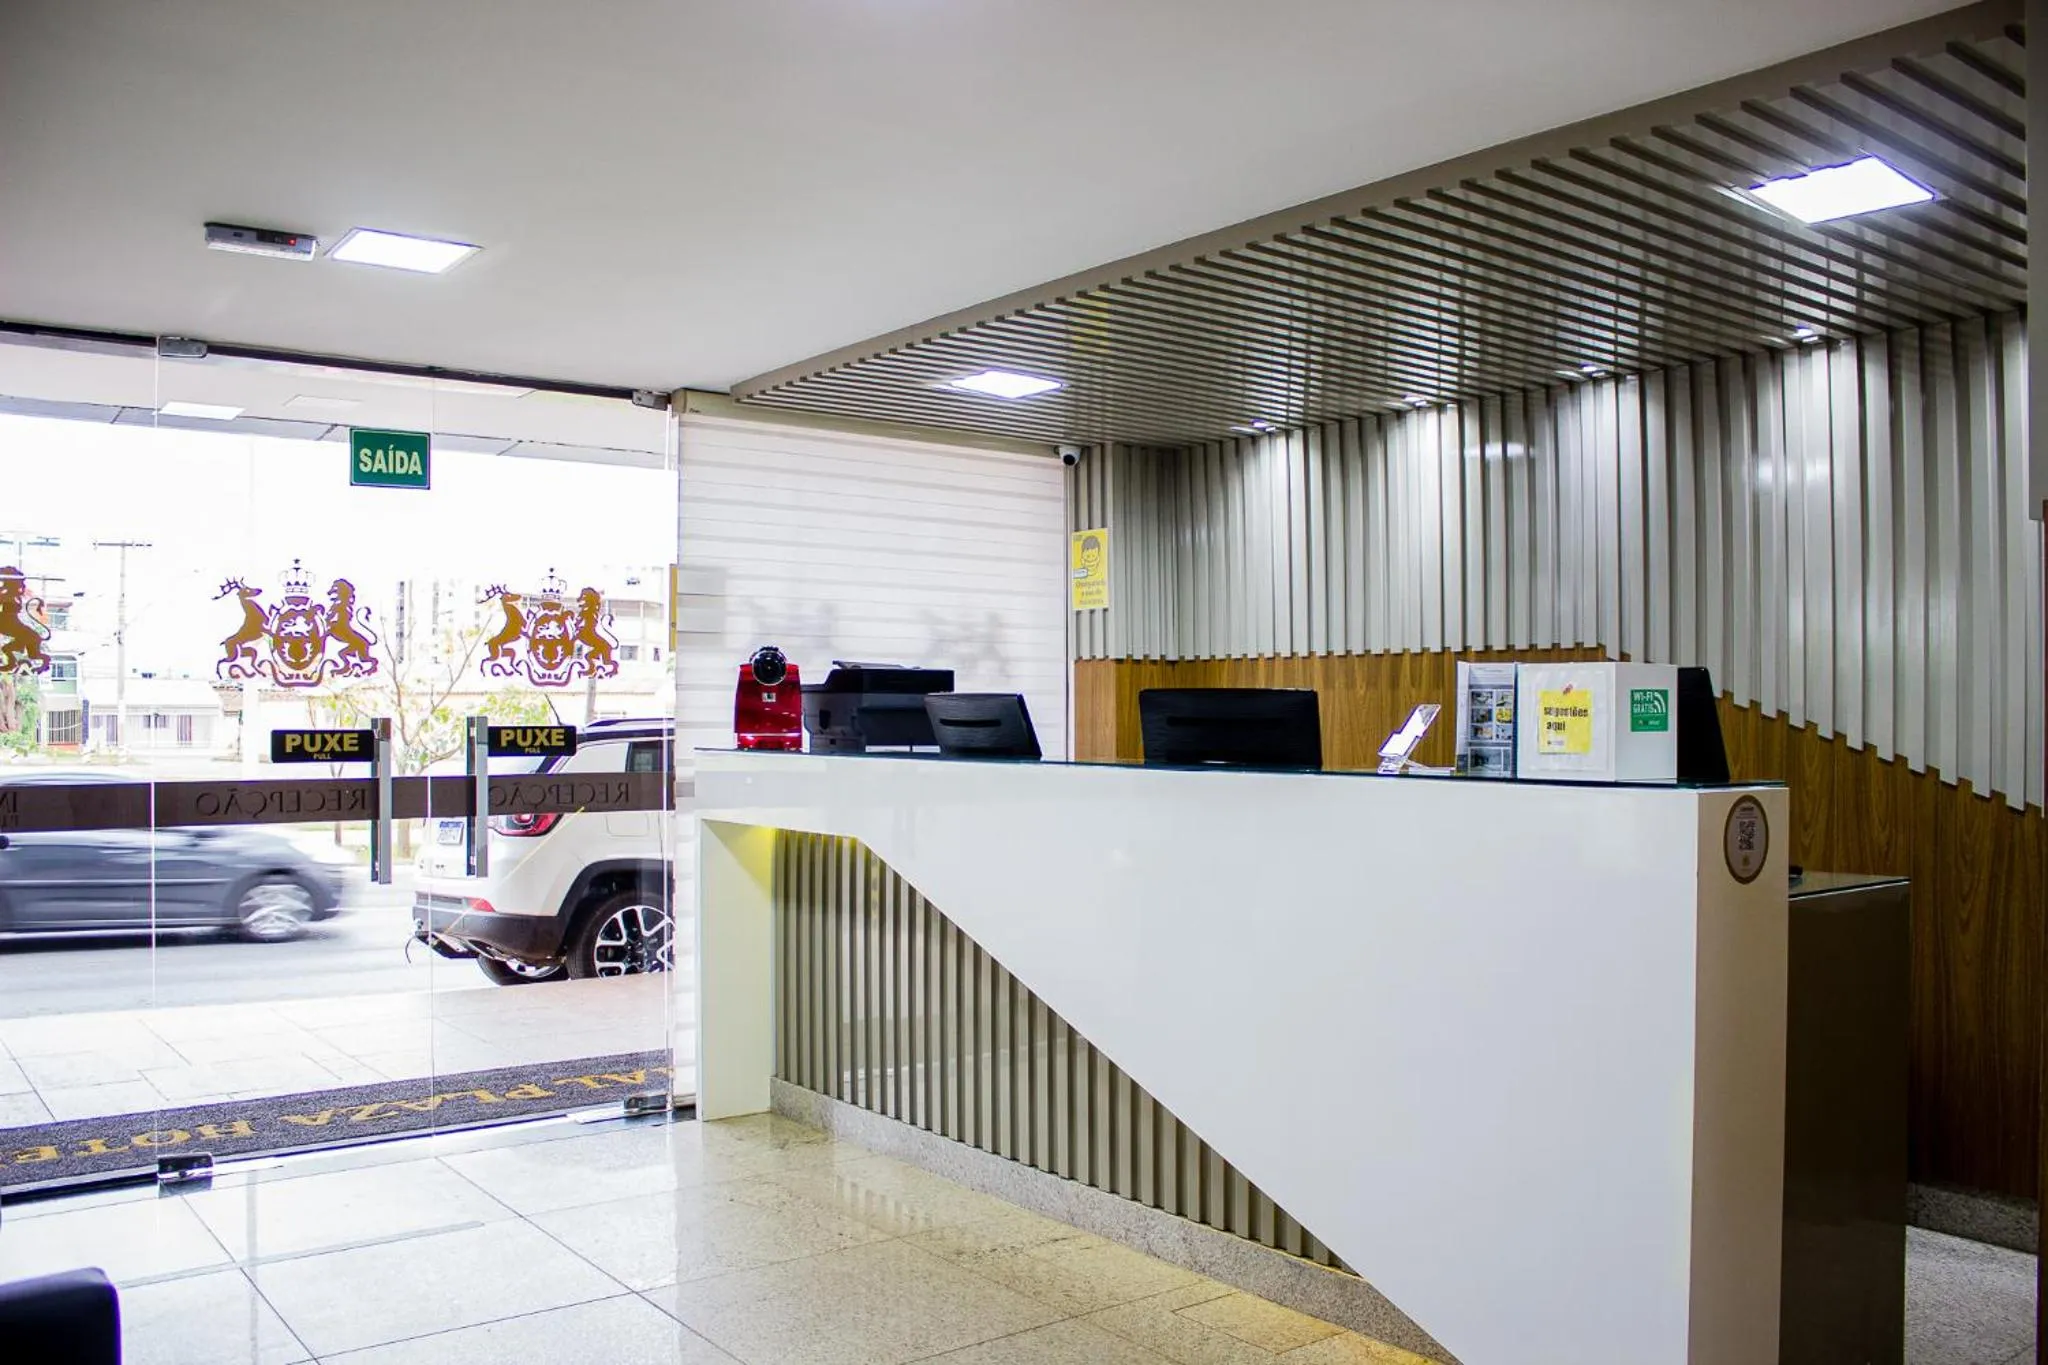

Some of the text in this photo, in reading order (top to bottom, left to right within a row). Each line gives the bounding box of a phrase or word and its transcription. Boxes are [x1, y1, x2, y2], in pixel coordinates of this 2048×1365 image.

[358, 444, 423, 475] SAÍDA
[1546, 721, 1566, 731] aqui
[284, 732, 360, 753] PUXE
[500, 728, 566, 748] PUXE
[0, 1067, 672, 1168] AL PLAZA HOTE
